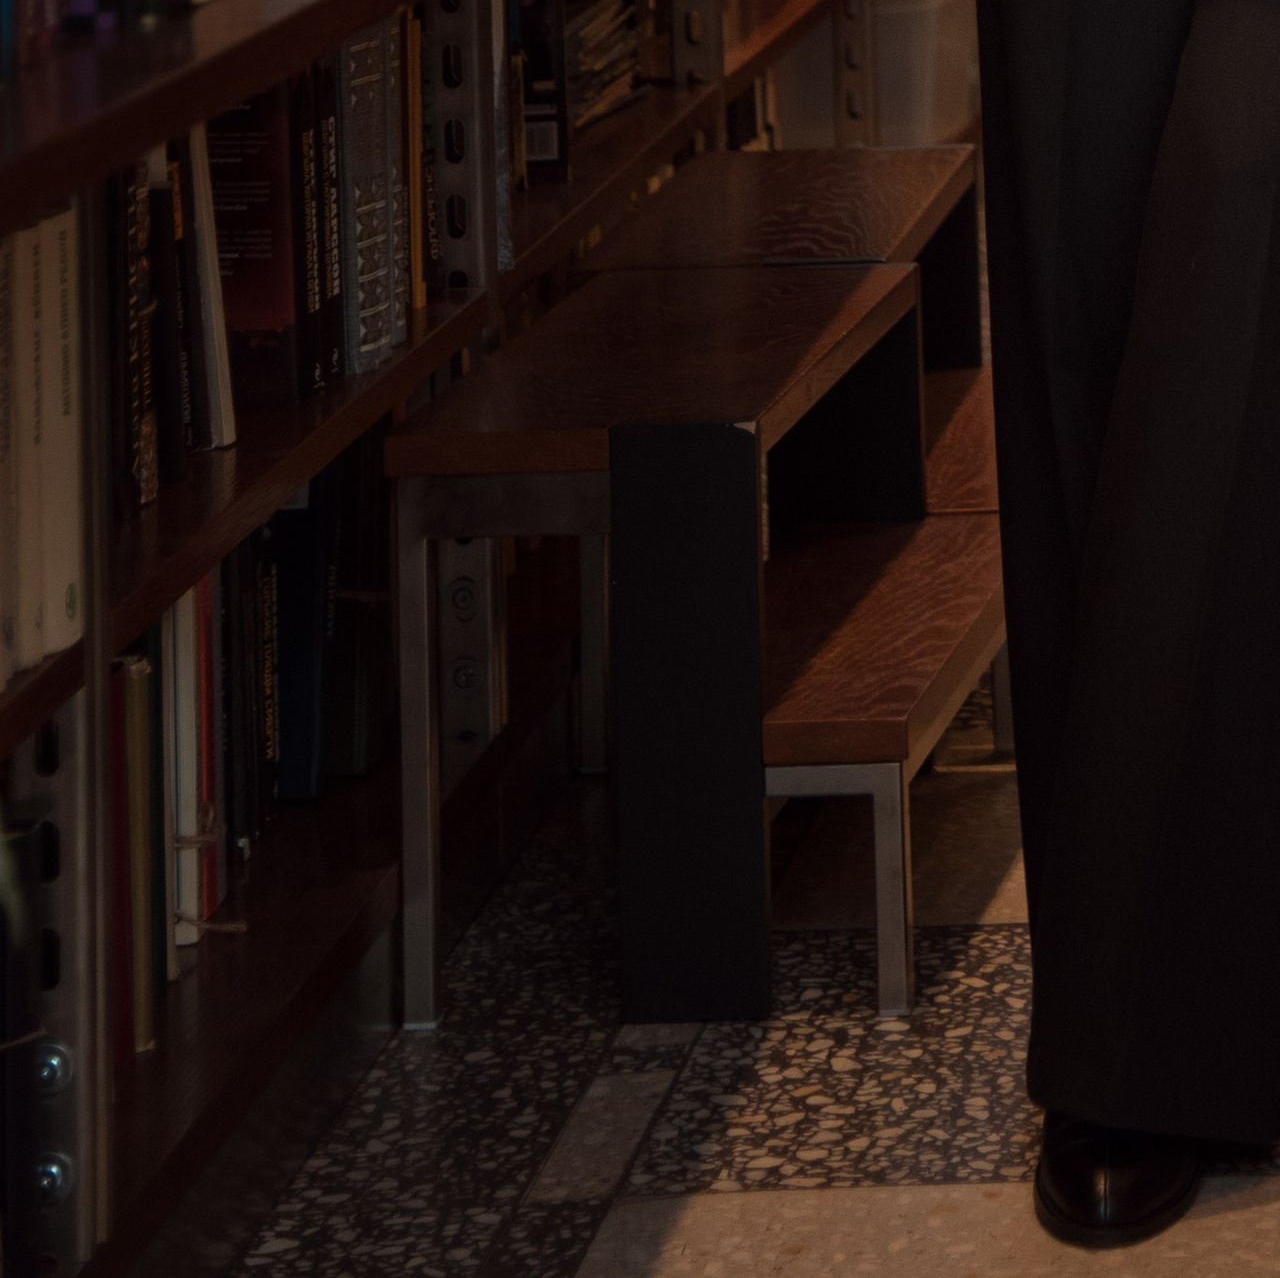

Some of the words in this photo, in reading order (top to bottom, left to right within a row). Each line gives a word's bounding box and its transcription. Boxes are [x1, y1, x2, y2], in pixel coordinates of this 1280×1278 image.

[327, 115, 336, 178] СТИГ
[59, 229, 68, 284] РЕДОЛ
[329, 186, 340, 296] ЛАРССОН
[61, 344, 70, 415] АНТОНИО
[264, 699, 274, 759] СМЕРТИ
